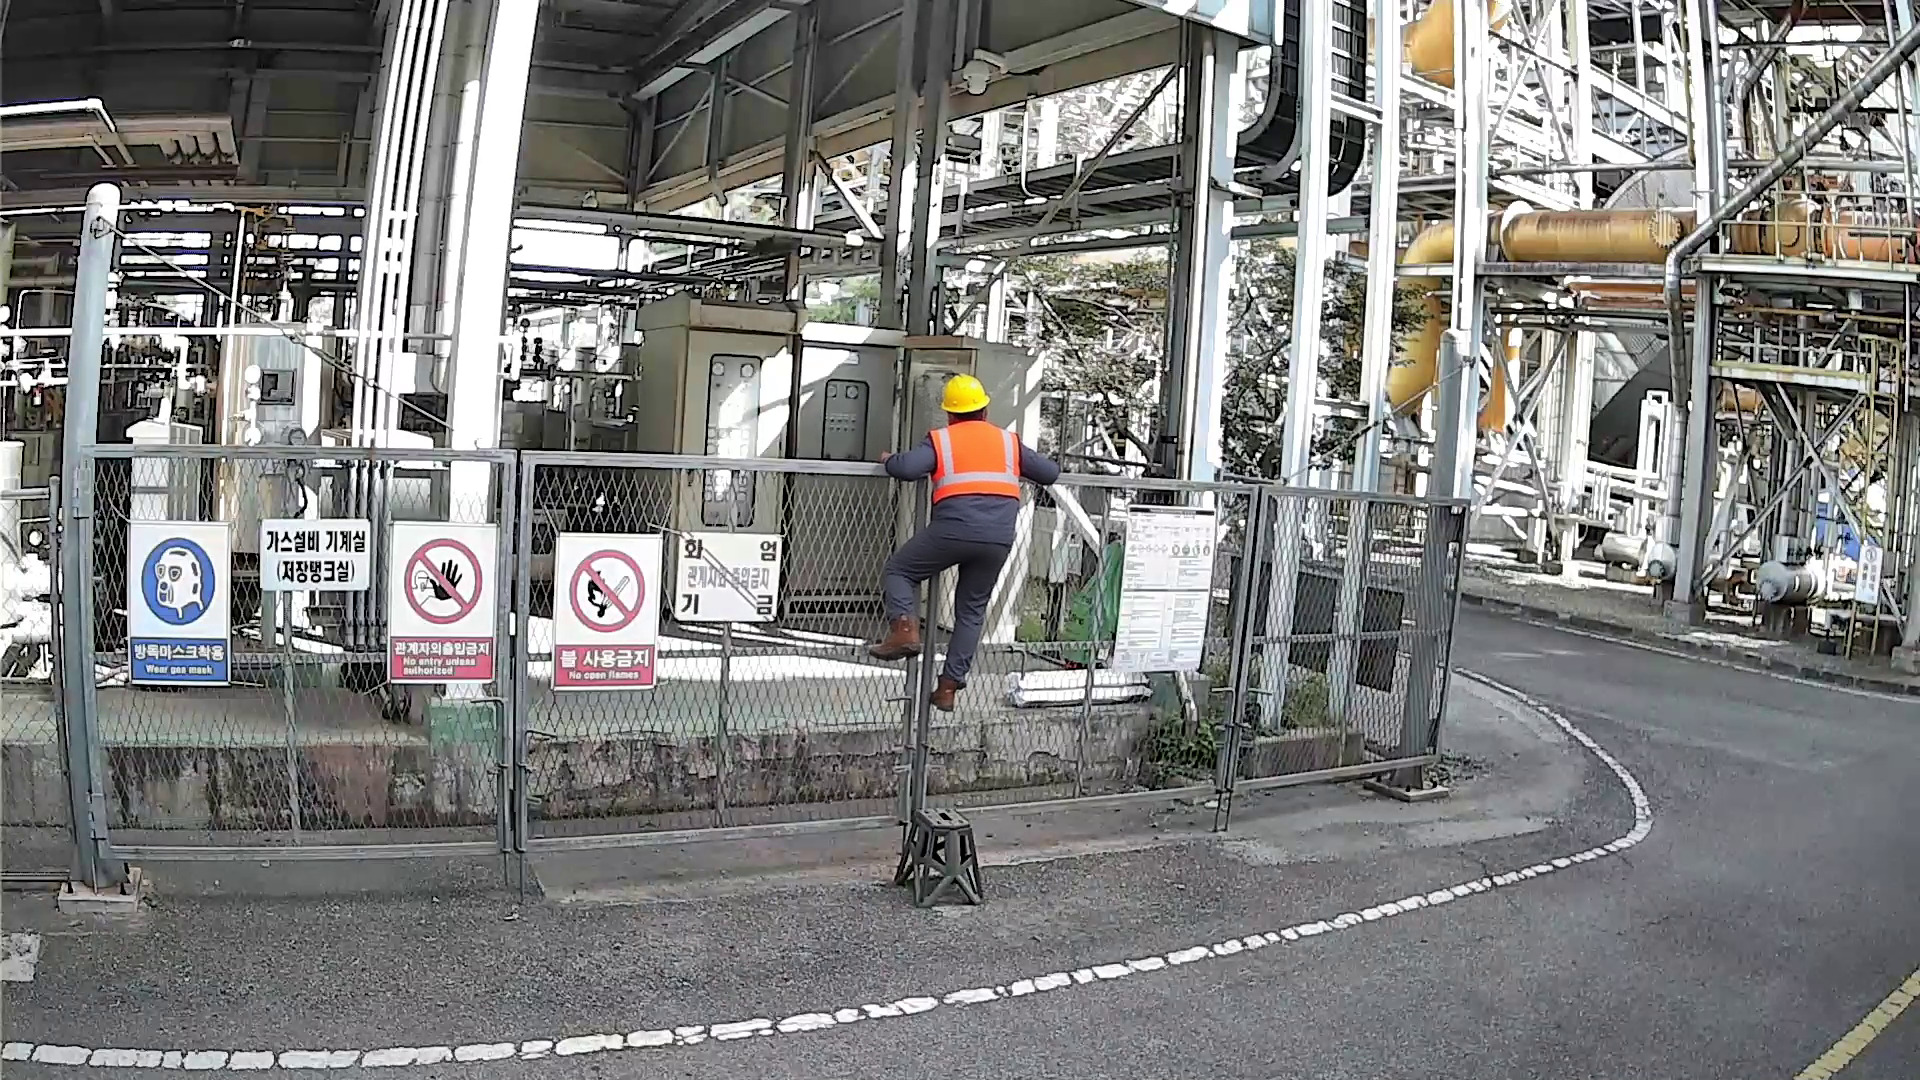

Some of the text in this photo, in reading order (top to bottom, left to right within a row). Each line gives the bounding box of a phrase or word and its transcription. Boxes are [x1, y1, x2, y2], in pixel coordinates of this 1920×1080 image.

[266, 530, 366, 553] 가스설비 기계실
[684, 539, 778, 562] 화 엄
[276, 559, 355, 584] (저장탱크실)
[681, 593, 773, 615] 기 금
[134, 643, 225, 661] 방독마스크착용
[394, 642, 490, 656] 관계자외출입금지
[560, 648, 650, 668] 불 사용금지
[145, 664, 213, 675] Wear gas mask
[403, 657, 477, 667] No entry unless
[403, 666, 454, 676] authorized
[568, 670, 639, 681] No open flames
